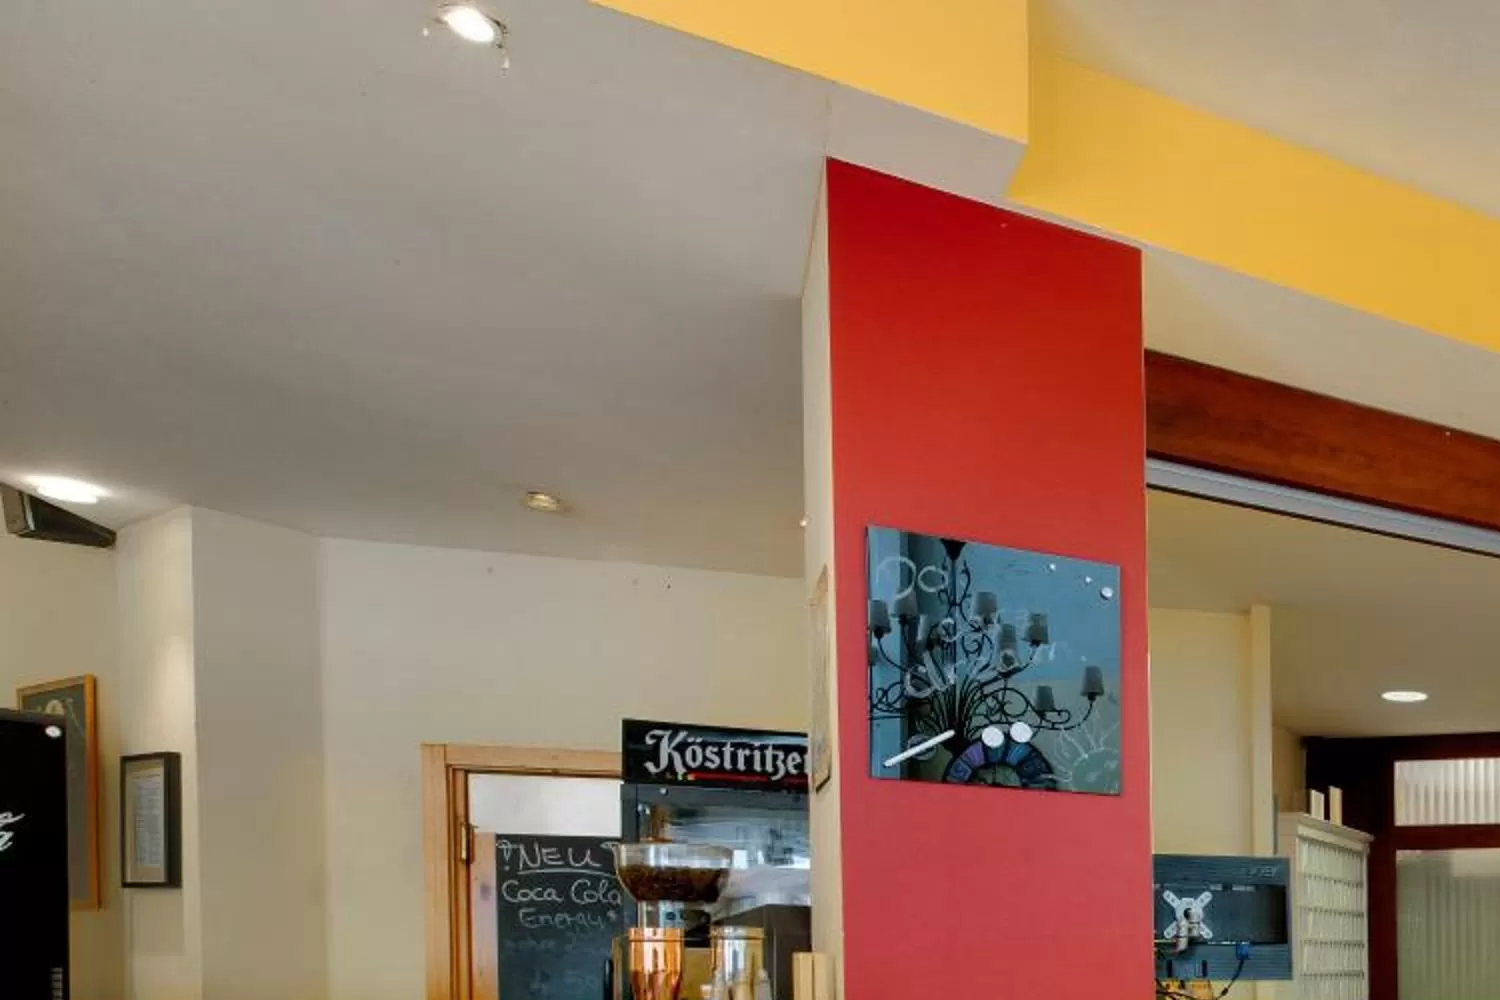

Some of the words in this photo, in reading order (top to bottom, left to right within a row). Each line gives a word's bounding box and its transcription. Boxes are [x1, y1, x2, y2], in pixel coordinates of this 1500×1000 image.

[644, 729, 808, 780] Köstritze
[502, 879, 564, 903] Coca
[571, 879, 622, 905] Cola
